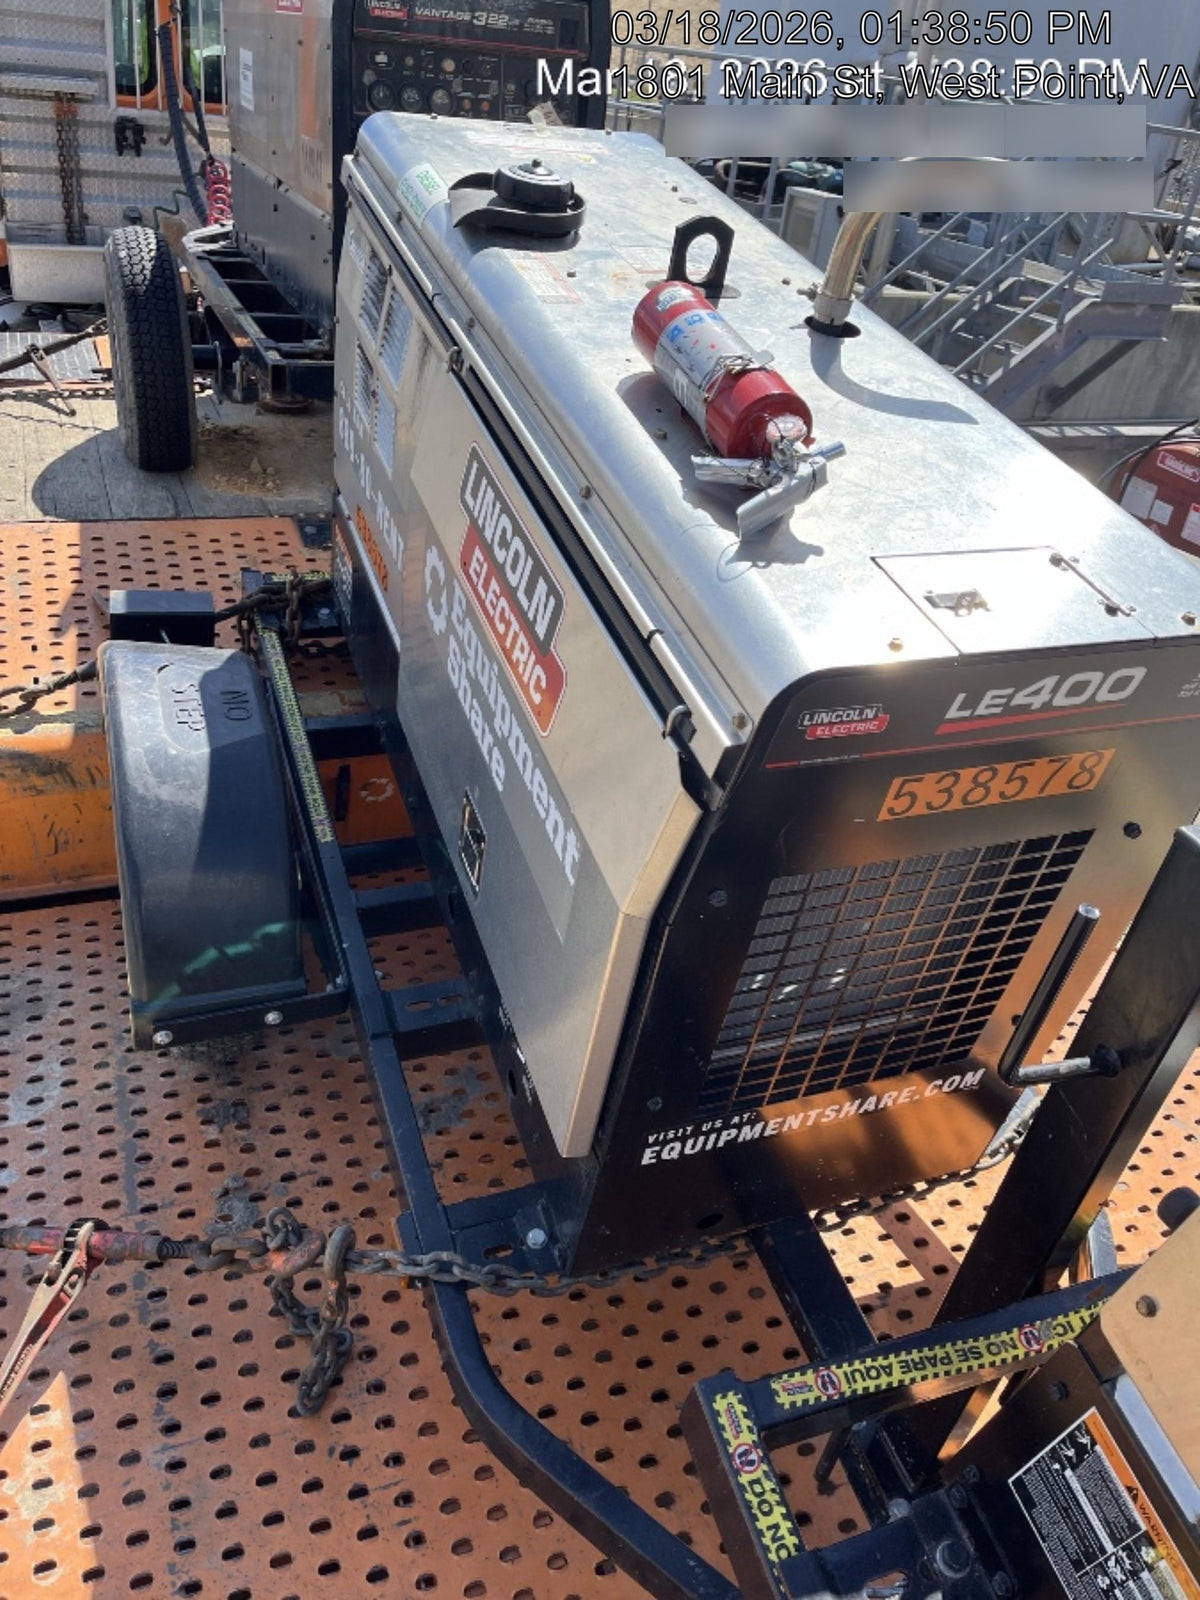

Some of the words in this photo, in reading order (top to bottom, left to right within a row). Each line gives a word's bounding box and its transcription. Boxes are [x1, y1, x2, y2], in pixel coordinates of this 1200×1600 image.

[415, 7, 472, 20] VANTAGE
[473, 12, 509, 28] 322
[464, 460, 555, 642] LINCOLN
[468, 545, 547, 706] ELECTRIC
[943, 666, 1148, 720] LE400
[448, 634, 506, 793] Share
[451, 579, 581, 887] Equipment
[803, 706, 878, 727] LINCOLN
[815, 720, 880, 737] ELECTRIC
[886, 749, 1106, 818] 538578
[641, 1067, 987, 1166] EQUIPMENTSHARE.COM
[648, 1125, 693, 1144] VISIT
[702, 1119, 723, 1132] US
[730, 1112, 756, 1126] AT:
[899, 1352, 954, 1378] PARE
[957, 1343, 980, 1363] SE
[986, 1336, 1019, 1357] NO
[748, 1477, 774, 1517] DO
